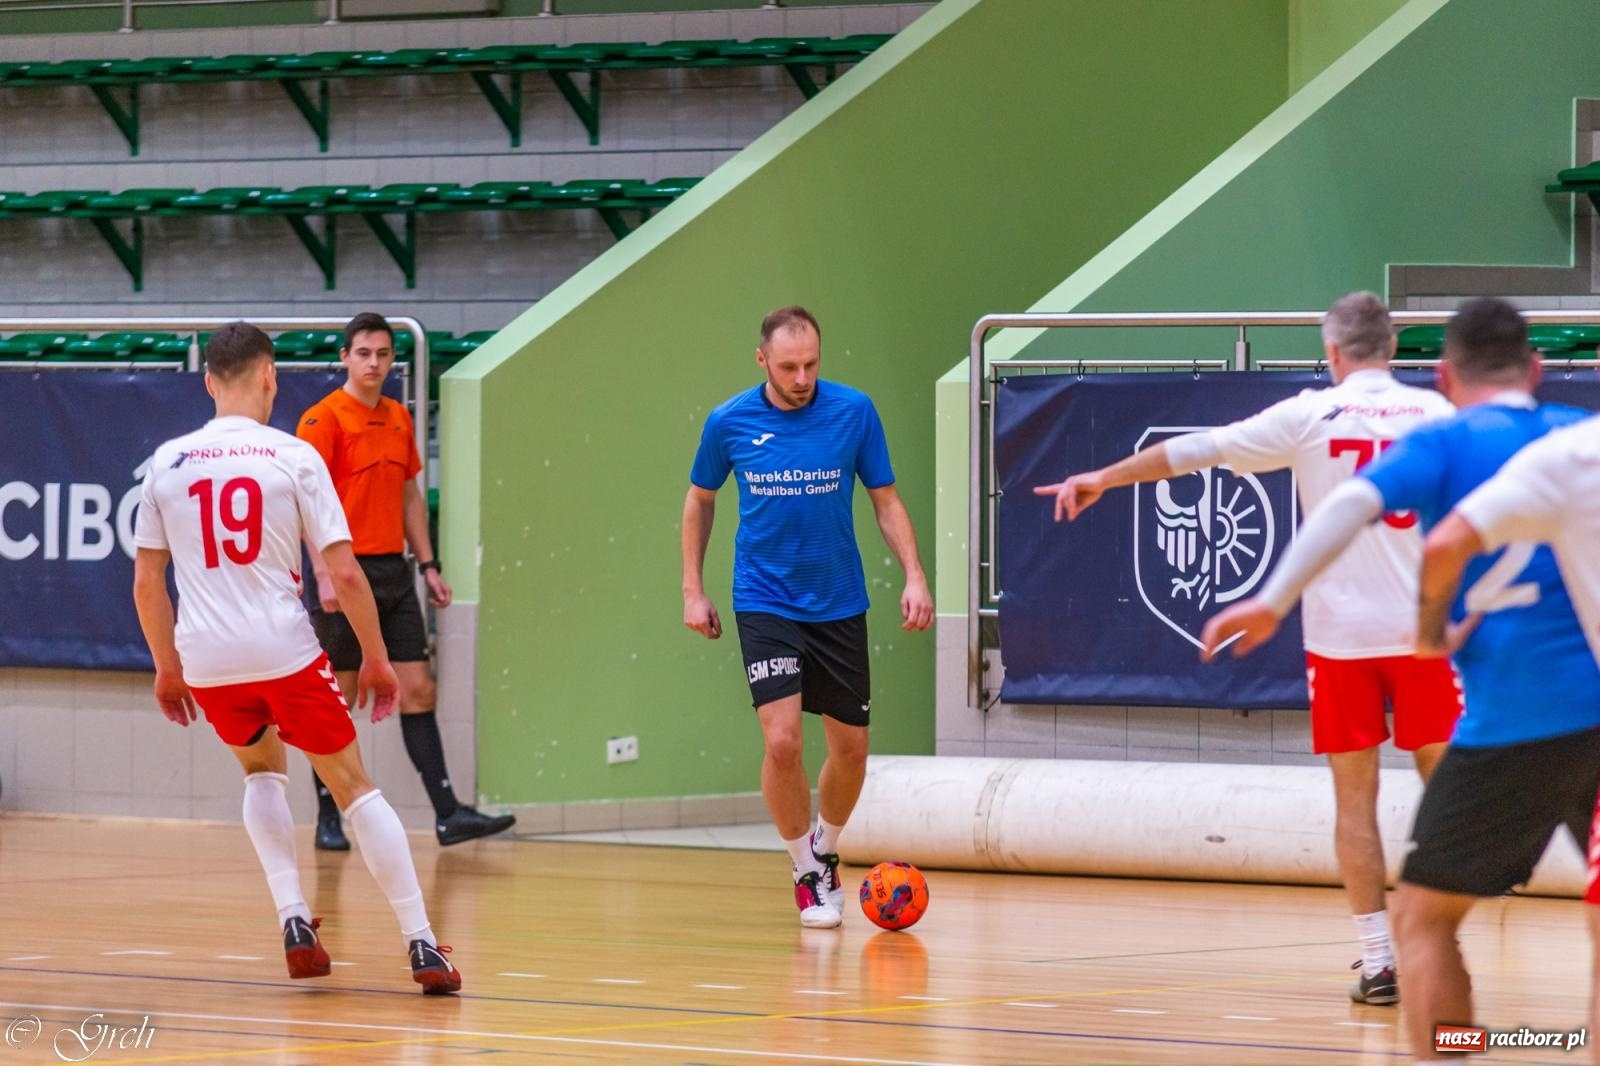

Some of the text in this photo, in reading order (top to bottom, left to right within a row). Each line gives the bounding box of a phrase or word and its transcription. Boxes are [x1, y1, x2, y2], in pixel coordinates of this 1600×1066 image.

[750, 481, 839, 496] Metallbau GmbH
[188, 476, 263, 569] 19
